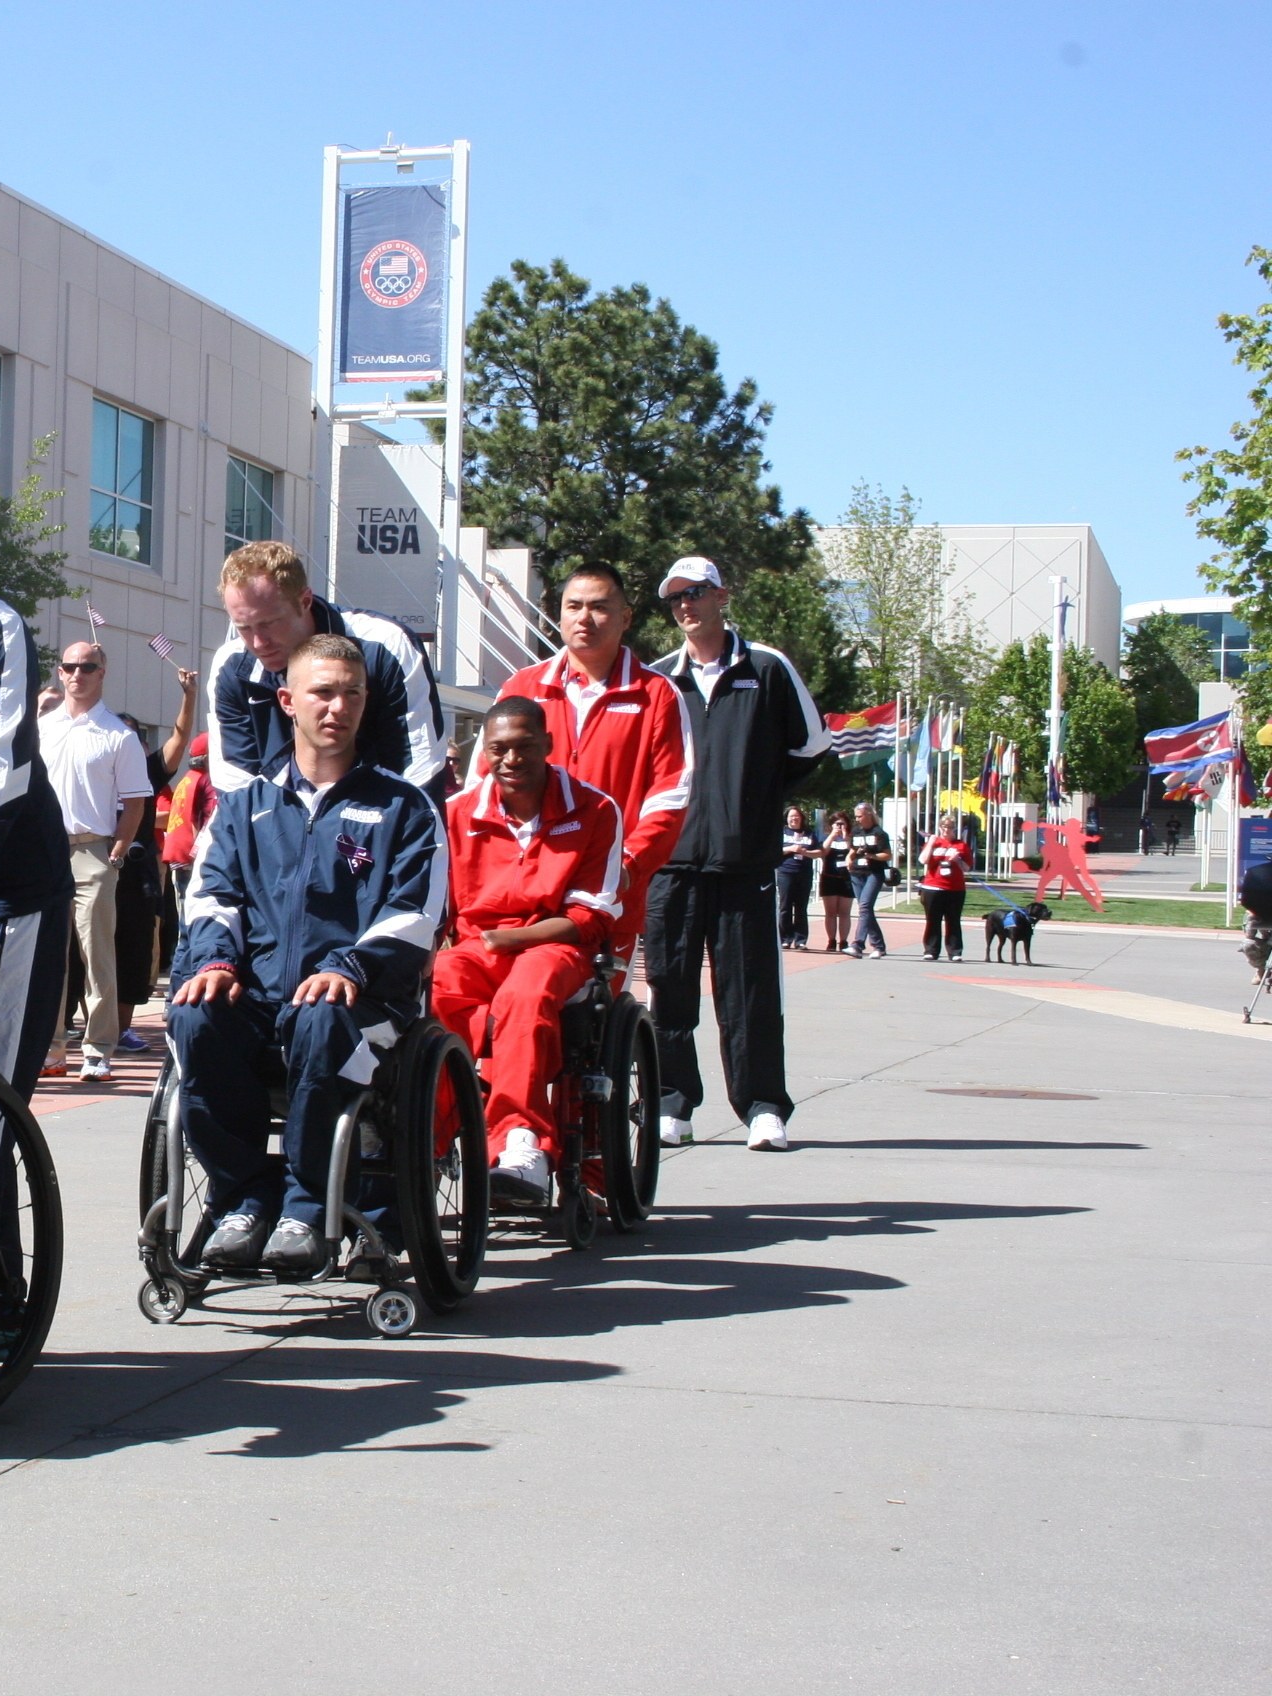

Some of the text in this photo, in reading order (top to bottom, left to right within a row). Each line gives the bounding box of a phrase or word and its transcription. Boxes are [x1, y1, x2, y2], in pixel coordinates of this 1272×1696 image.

[367, 243, 421, 263] UNITED STATES
[364, 281, 423, 306] OLYMPIC TEAM
[352, 354, 431, 365] TEAMUSA.ORG
[356, 507, 417, 523] TEAM
[357, 524, 421, 555] USA
